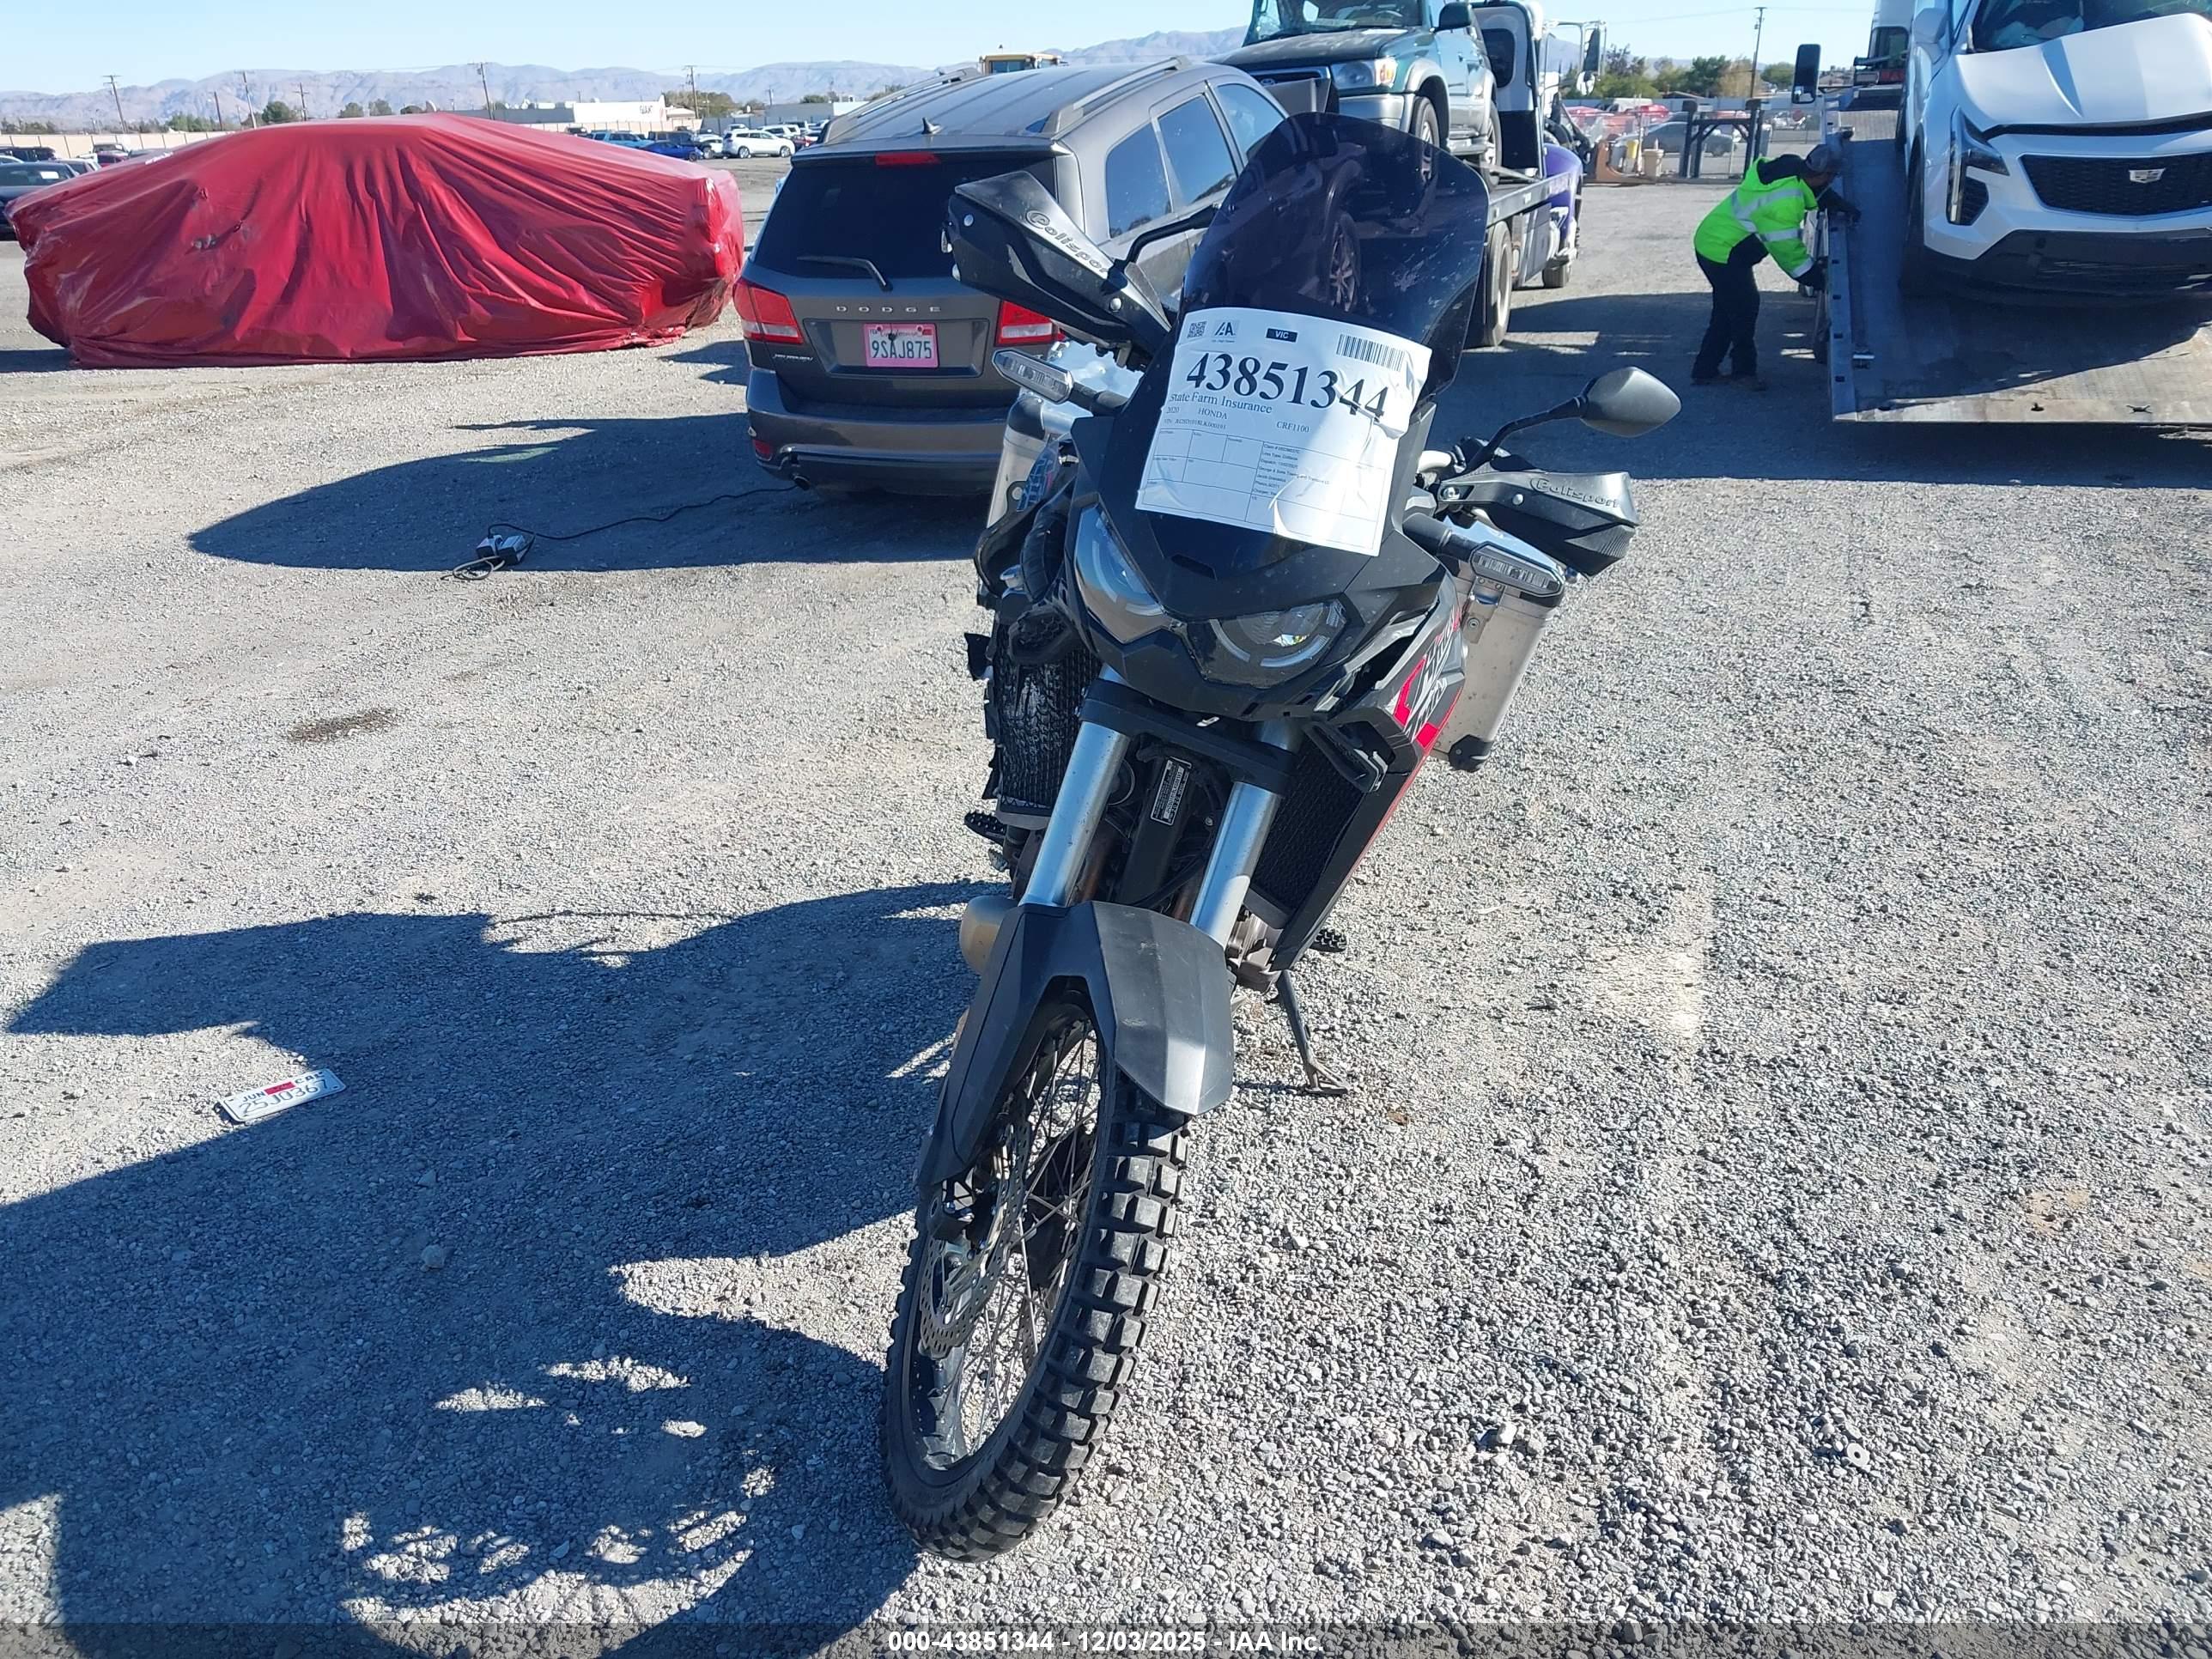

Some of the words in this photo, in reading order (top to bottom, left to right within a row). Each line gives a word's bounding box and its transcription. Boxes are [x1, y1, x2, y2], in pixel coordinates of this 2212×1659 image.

[1025, 210, 1109, 274] Polispor
[871, 340, 933, 359] 9SAJ875
[1275, 330, 1290, 339] VIC
[1186, 352, 1389, 421] 43851344
[1170, 392, 1190, 403] State
[1192, 392, 1218, 405] Farm
[1222, 396, 1273, 414] Insurance
[1199, 408, 1228, 420] HONDA
[1276, 421, 1310, 433] CRF1100
[1530, 477, 1619, 508] Polisport
[239, 1079, 328, 1115] 25J0367
[241, 1091, 265, 1103] JUN
[294, 1071, 326, 1085] CAL
